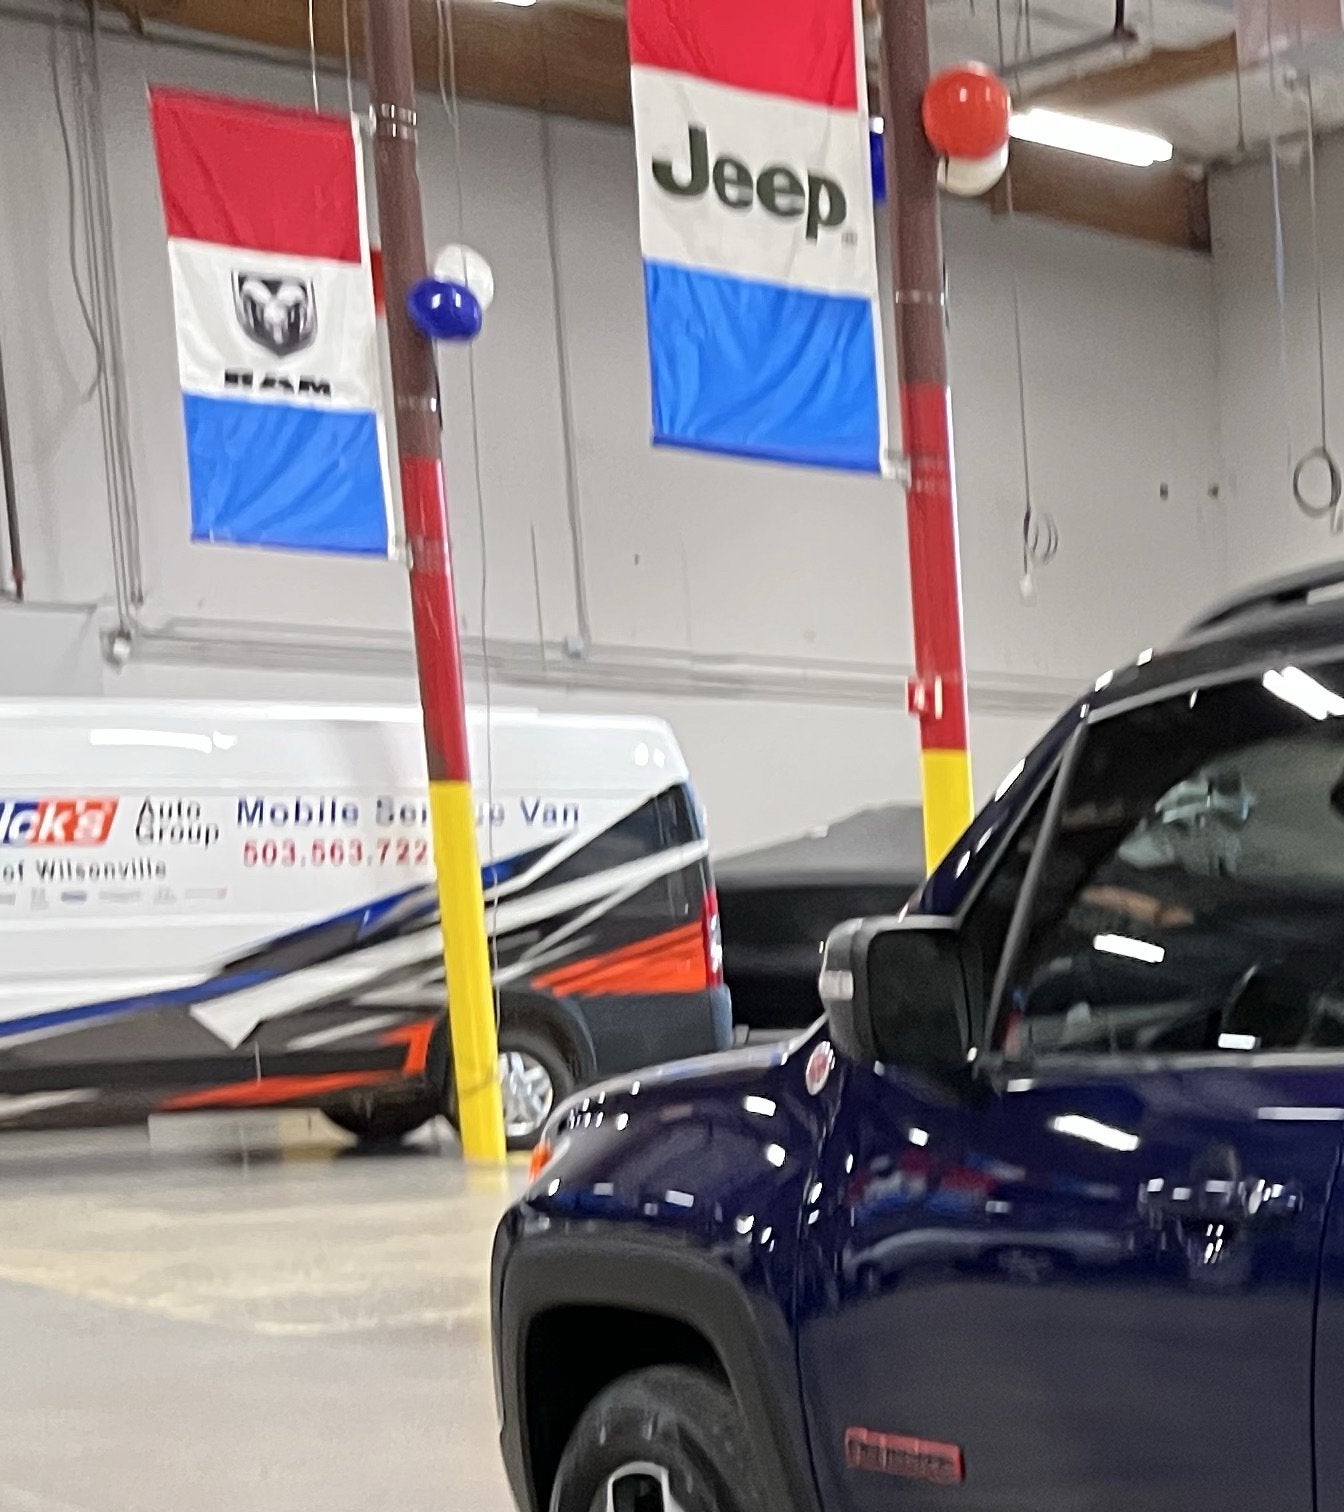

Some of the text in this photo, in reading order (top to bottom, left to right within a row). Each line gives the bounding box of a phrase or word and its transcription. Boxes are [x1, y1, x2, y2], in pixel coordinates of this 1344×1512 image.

[651, 121, 848, 245] Jeep
[0, 799, 106, 846] ick's
[137, 795, 201, 821] Auto
[236, 796, 579, 828] Mobile Serce Van
[136, 820, 220, 850] Group
[243, 838, 429, 868] 503.563.722
[2, 857, 167, 883] of Wilsonville
